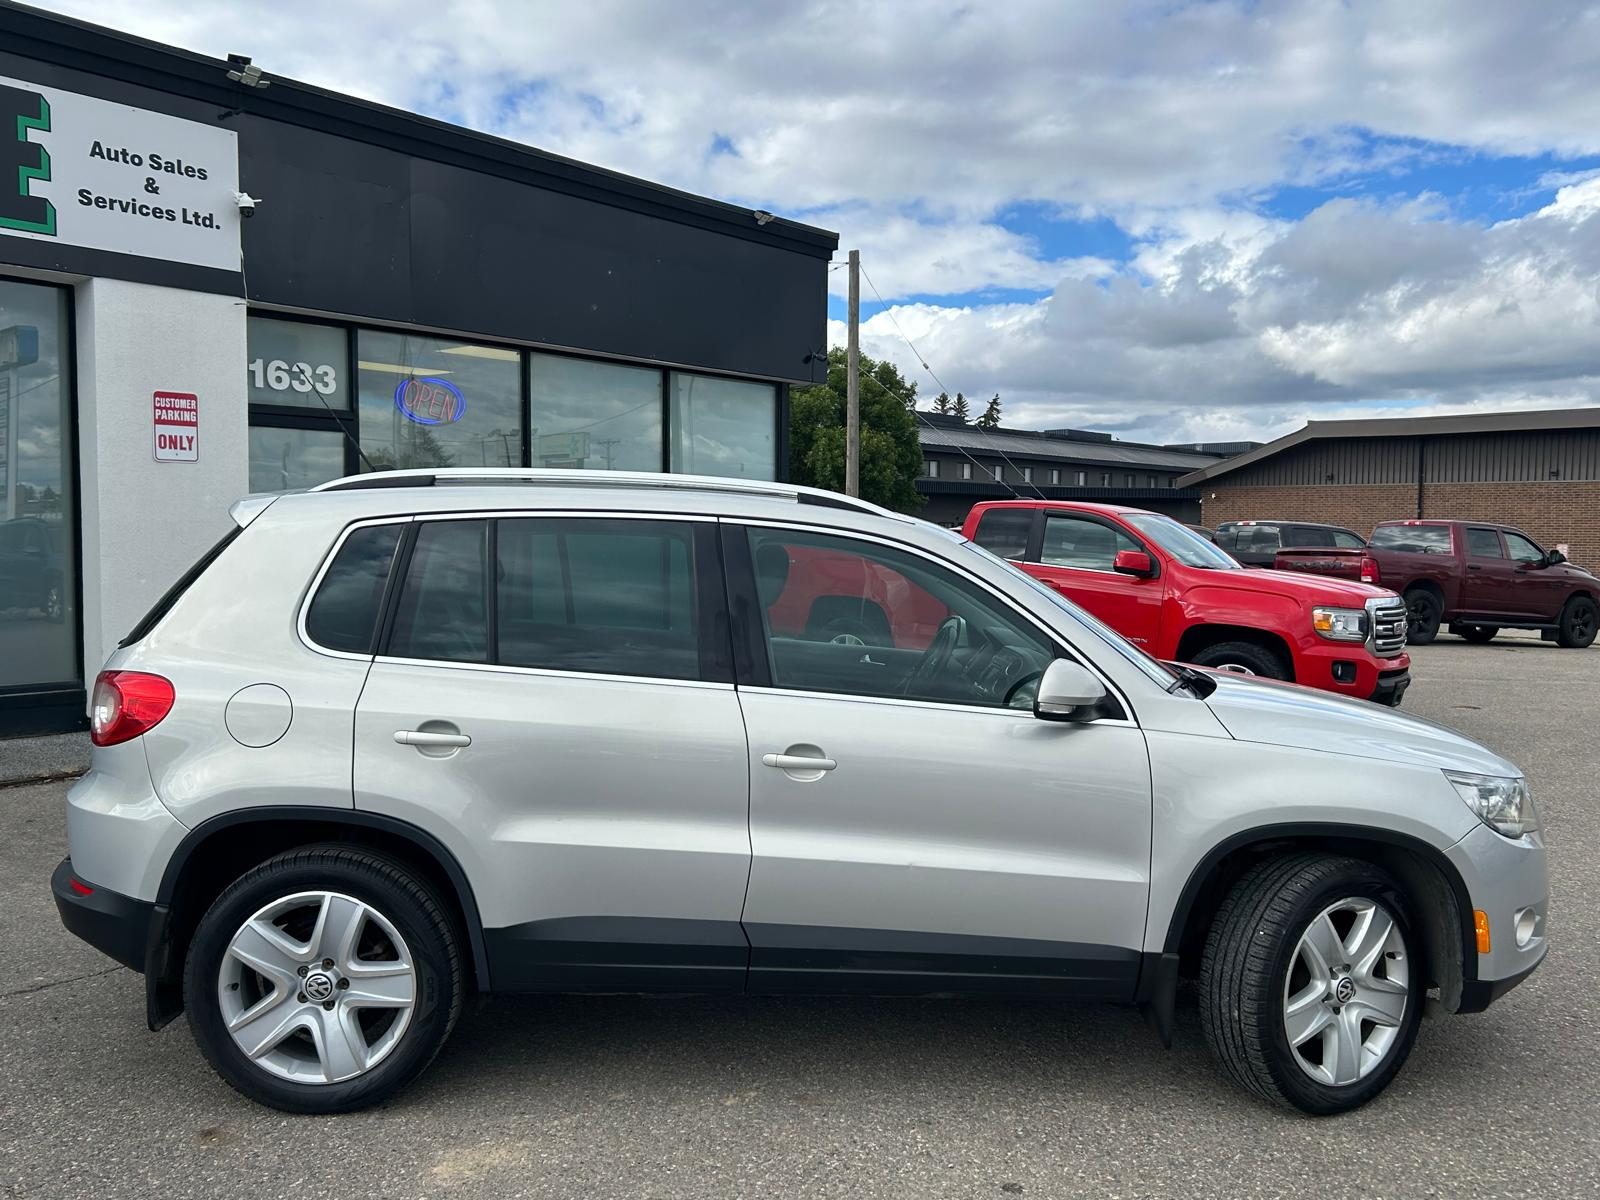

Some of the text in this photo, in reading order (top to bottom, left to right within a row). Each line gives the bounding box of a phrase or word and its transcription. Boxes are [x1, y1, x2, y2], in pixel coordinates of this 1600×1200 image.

[89, 141, 208, 180] Auto Sales
[144, 177, 160, 194] &
[78, 189, 221, 230] Services Ltd.
[249, 359, 337, 395] 1633
[155, 397, 197, 410] CUSTOMER
[404, 380, 456, 422] OPEN
[155, 409, 197, 423] PARKING
[158, 434, 195, 451] ONLY
